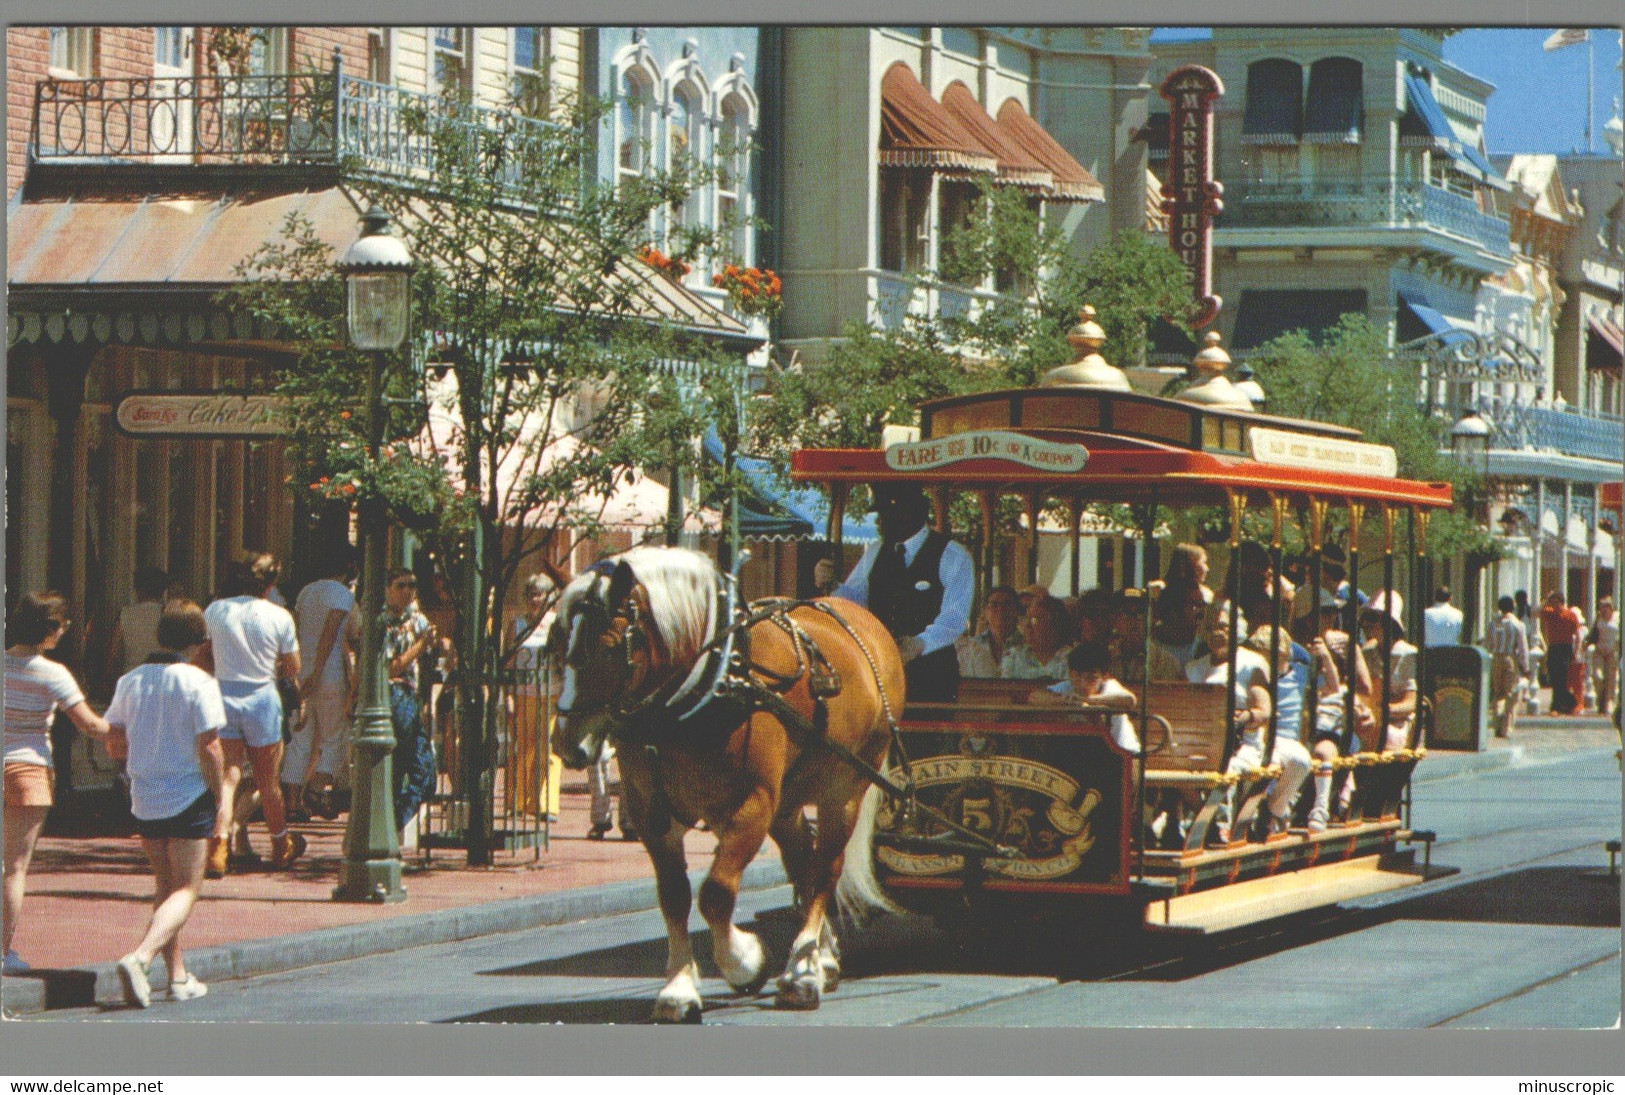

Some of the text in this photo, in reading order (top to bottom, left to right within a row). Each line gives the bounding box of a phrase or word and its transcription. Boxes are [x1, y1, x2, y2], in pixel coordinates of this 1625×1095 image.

[1181, 93, 1199, 299] MARKET HOUS
[896, 444, 943, 466] FARE
[970, 760, 1056, 788] STREET
[962, 798, 993, 830] 5
